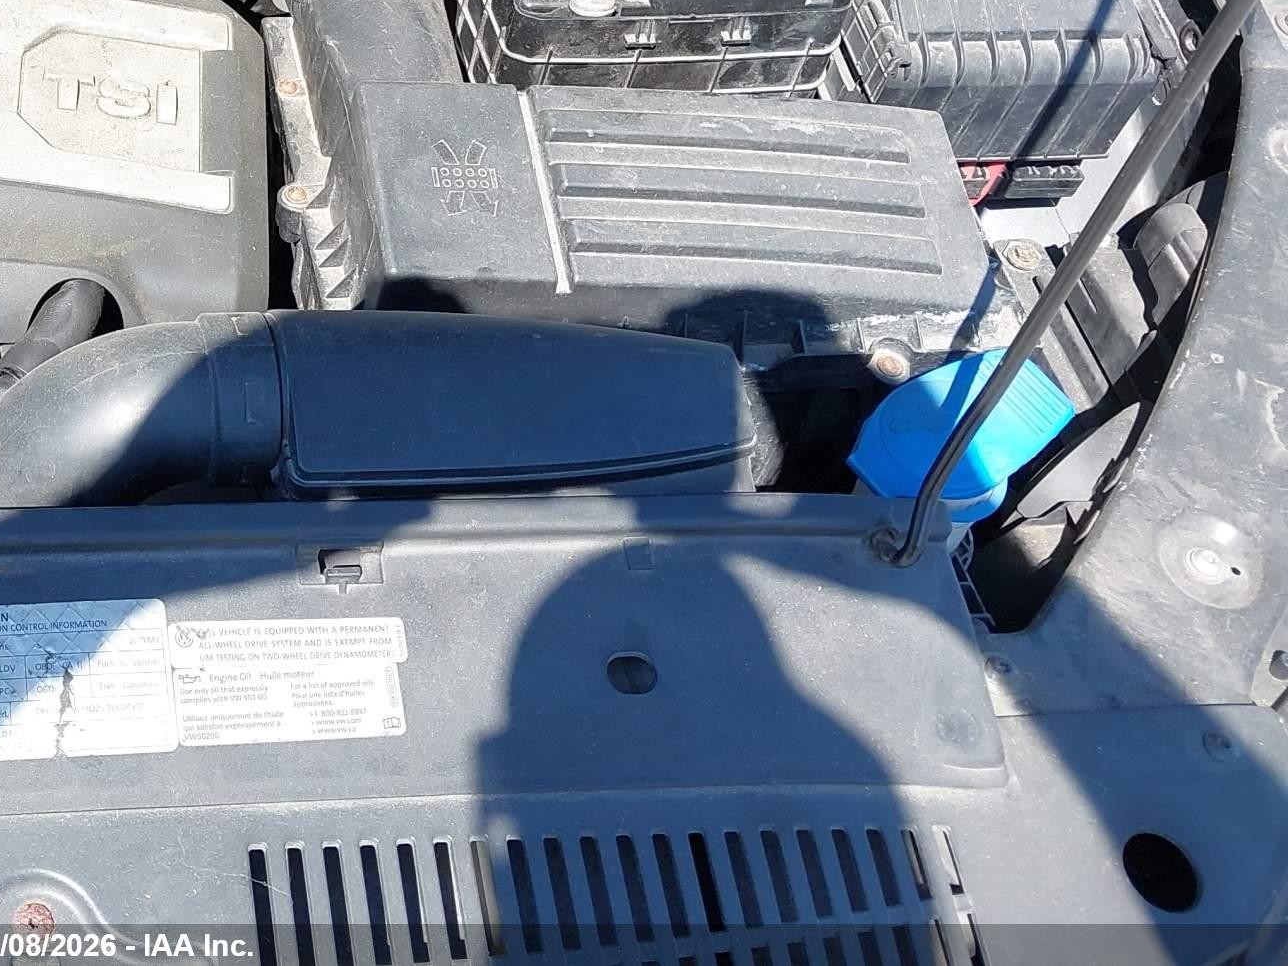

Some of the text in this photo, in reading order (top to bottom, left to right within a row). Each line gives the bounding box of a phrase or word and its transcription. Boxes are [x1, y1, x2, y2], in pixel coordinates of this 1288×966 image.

[43, 74, 179, 126] TSI
[11, 621, 48, 632] CONTROL
[50, 619, 108, 630] INFORMATION
[264, 626, 305, 636] EQUIPPED
[306, 626, 329, 635] WITH
[330, 626, 338, 634] A
[339, 625, 390, 634] PERMANENT
[244, 639, 270, 649] DRIVE
[271, 639, 302, 648] SYSTEM
[304, 638, 322, 648] AND
[368, 636, 393, 646] FROM
[215, 652, 246, 662] TESTING
[247, 652, 260, 661] ON
[262, 651, 308, 661] TWO-WHEEL
[309, 651, 332, 660] DRIVE
[0, 664, 16, 673] LDV
[209, 670, 315, 684] Engine Oil Huile moteur
